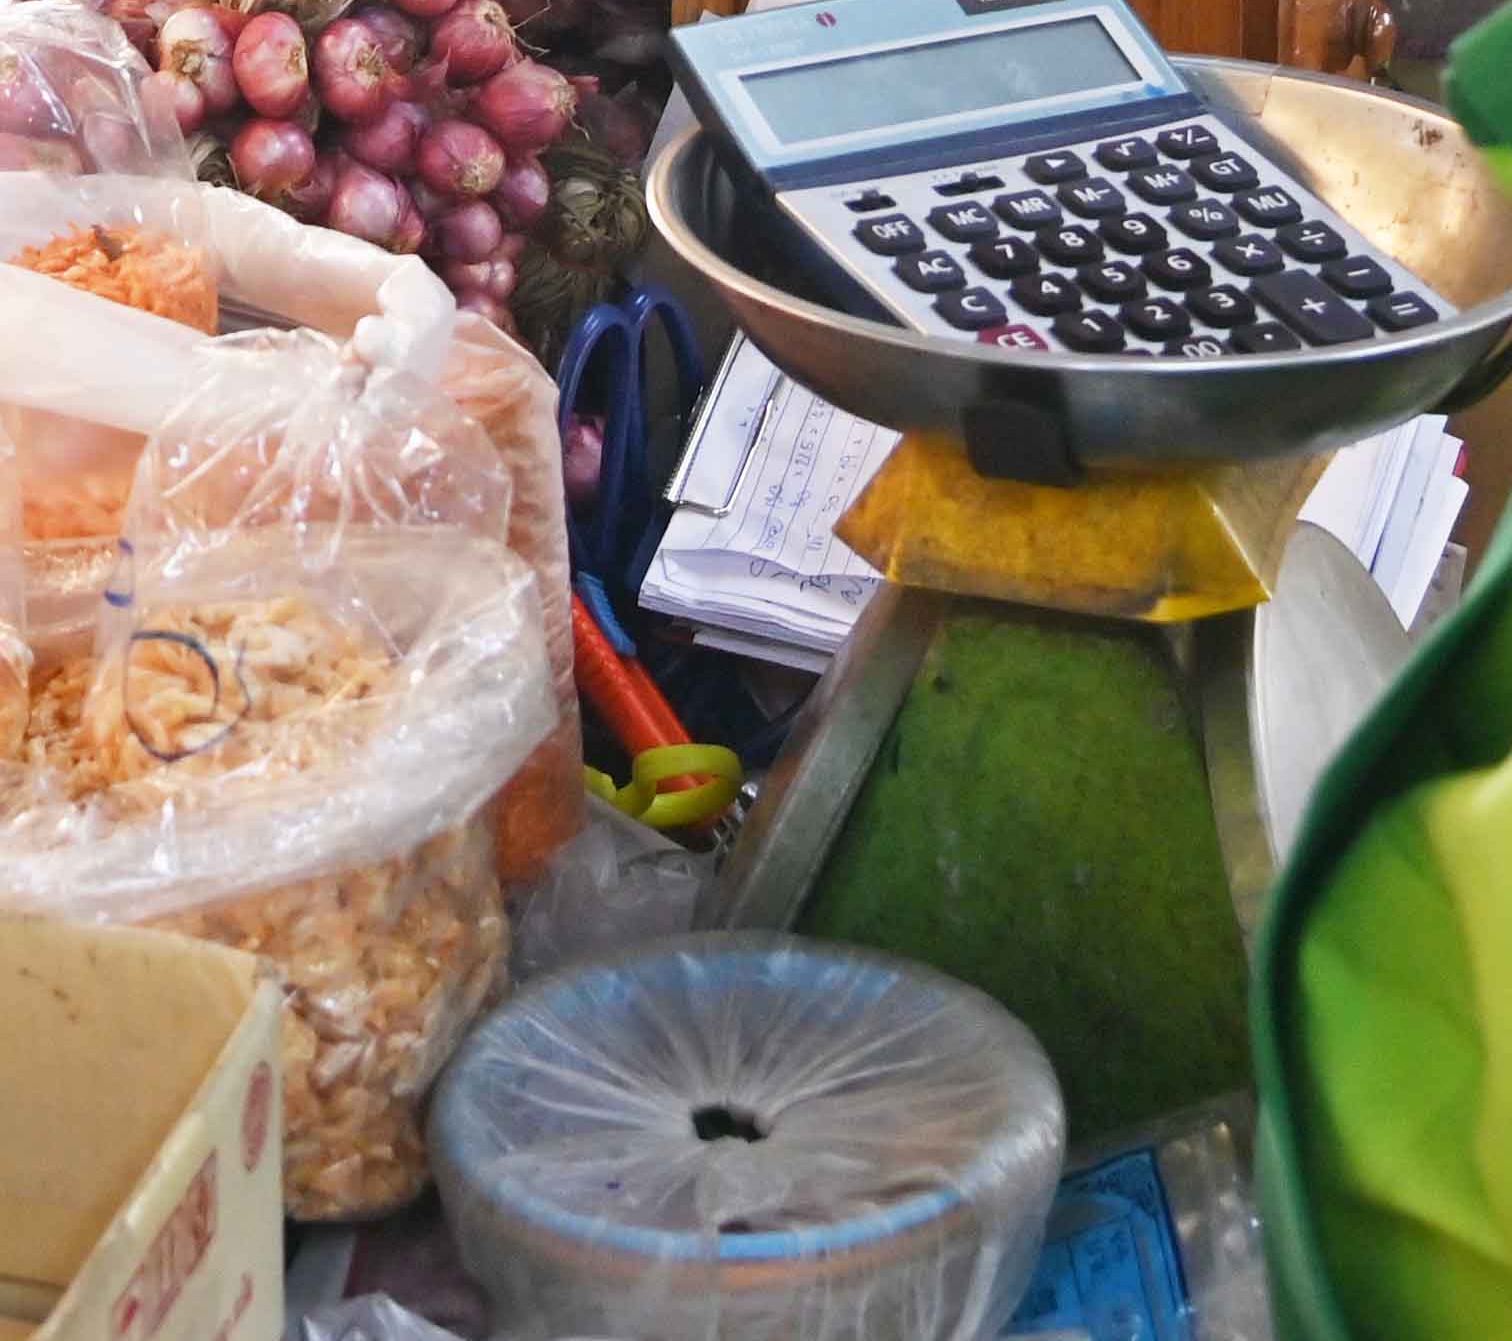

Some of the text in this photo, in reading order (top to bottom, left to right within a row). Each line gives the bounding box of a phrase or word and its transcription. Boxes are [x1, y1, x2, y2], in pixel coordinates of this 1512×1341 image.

[872, 219, 911, 239] OFF
[947, 208, 987, 227] MC
[1009, 197, 1052, 216] MR
[1143, 172, 1180, 190] M+
[1209, 158, 1241, 175] GT
[917, 194, 1289, 275] AC 7 8 9 % MU
[961, 295, 987, 312] C
[1040, 280, 1062, 296] 4
[1102, 267, 1126, 283] 5
[1167, 255, 1192, 271] 6
[996, 330, 1036, 348] CE
[1082, 317, 1104, 333] 1
[1144, 304, 1173, 321] 2
[1208, 292, 1236, 308] 3
[1183, 341, 1221, 358] 00
